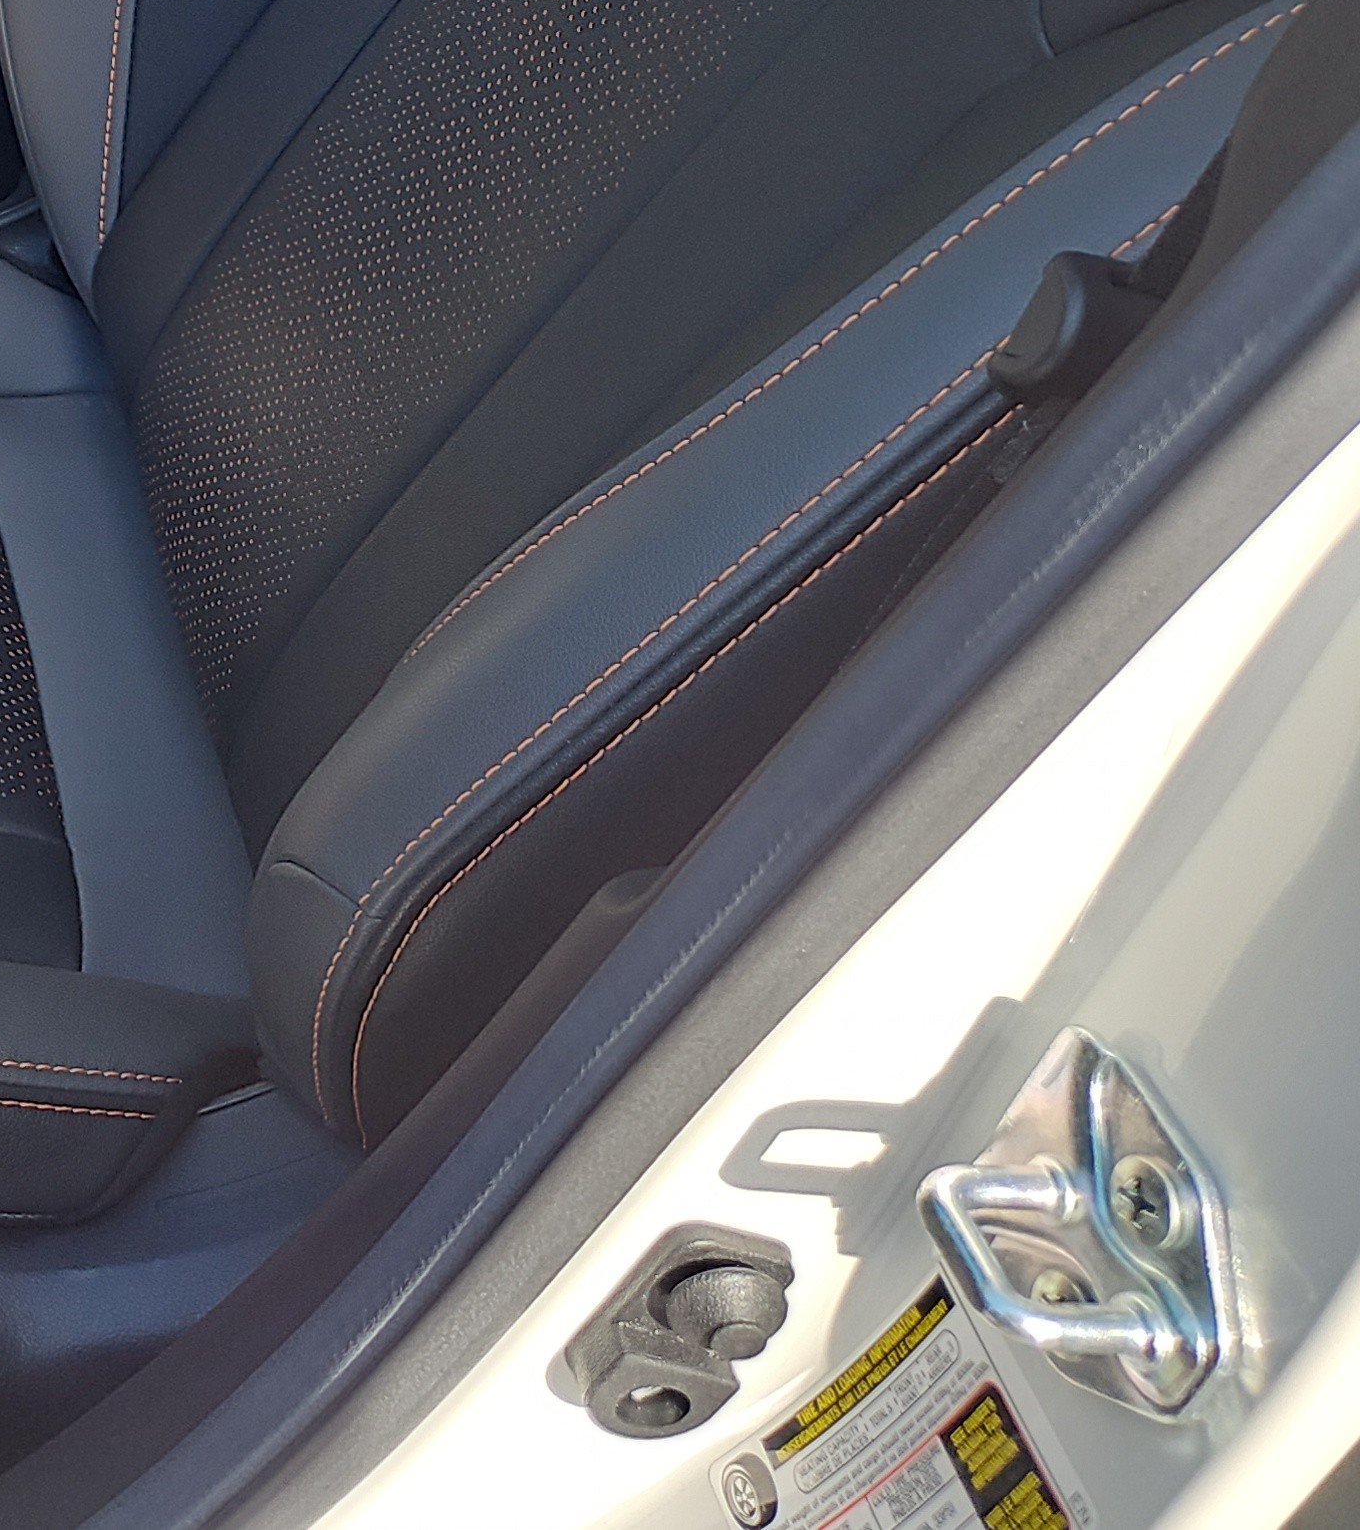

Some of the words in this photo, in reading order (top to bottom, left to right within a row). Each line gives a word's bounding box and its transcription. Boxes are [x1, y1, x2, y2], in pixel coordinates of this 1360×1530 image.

[796, 1401, 819, 1427] TIRE
[816, 1387, 837, 1412] AND
[833, 1355, 873, 1396] LOADING
[853, 1380, 870, 1400] LES
[887, 1349, 899, 1367] ET
[895, 1340, 909, 1359] LE
